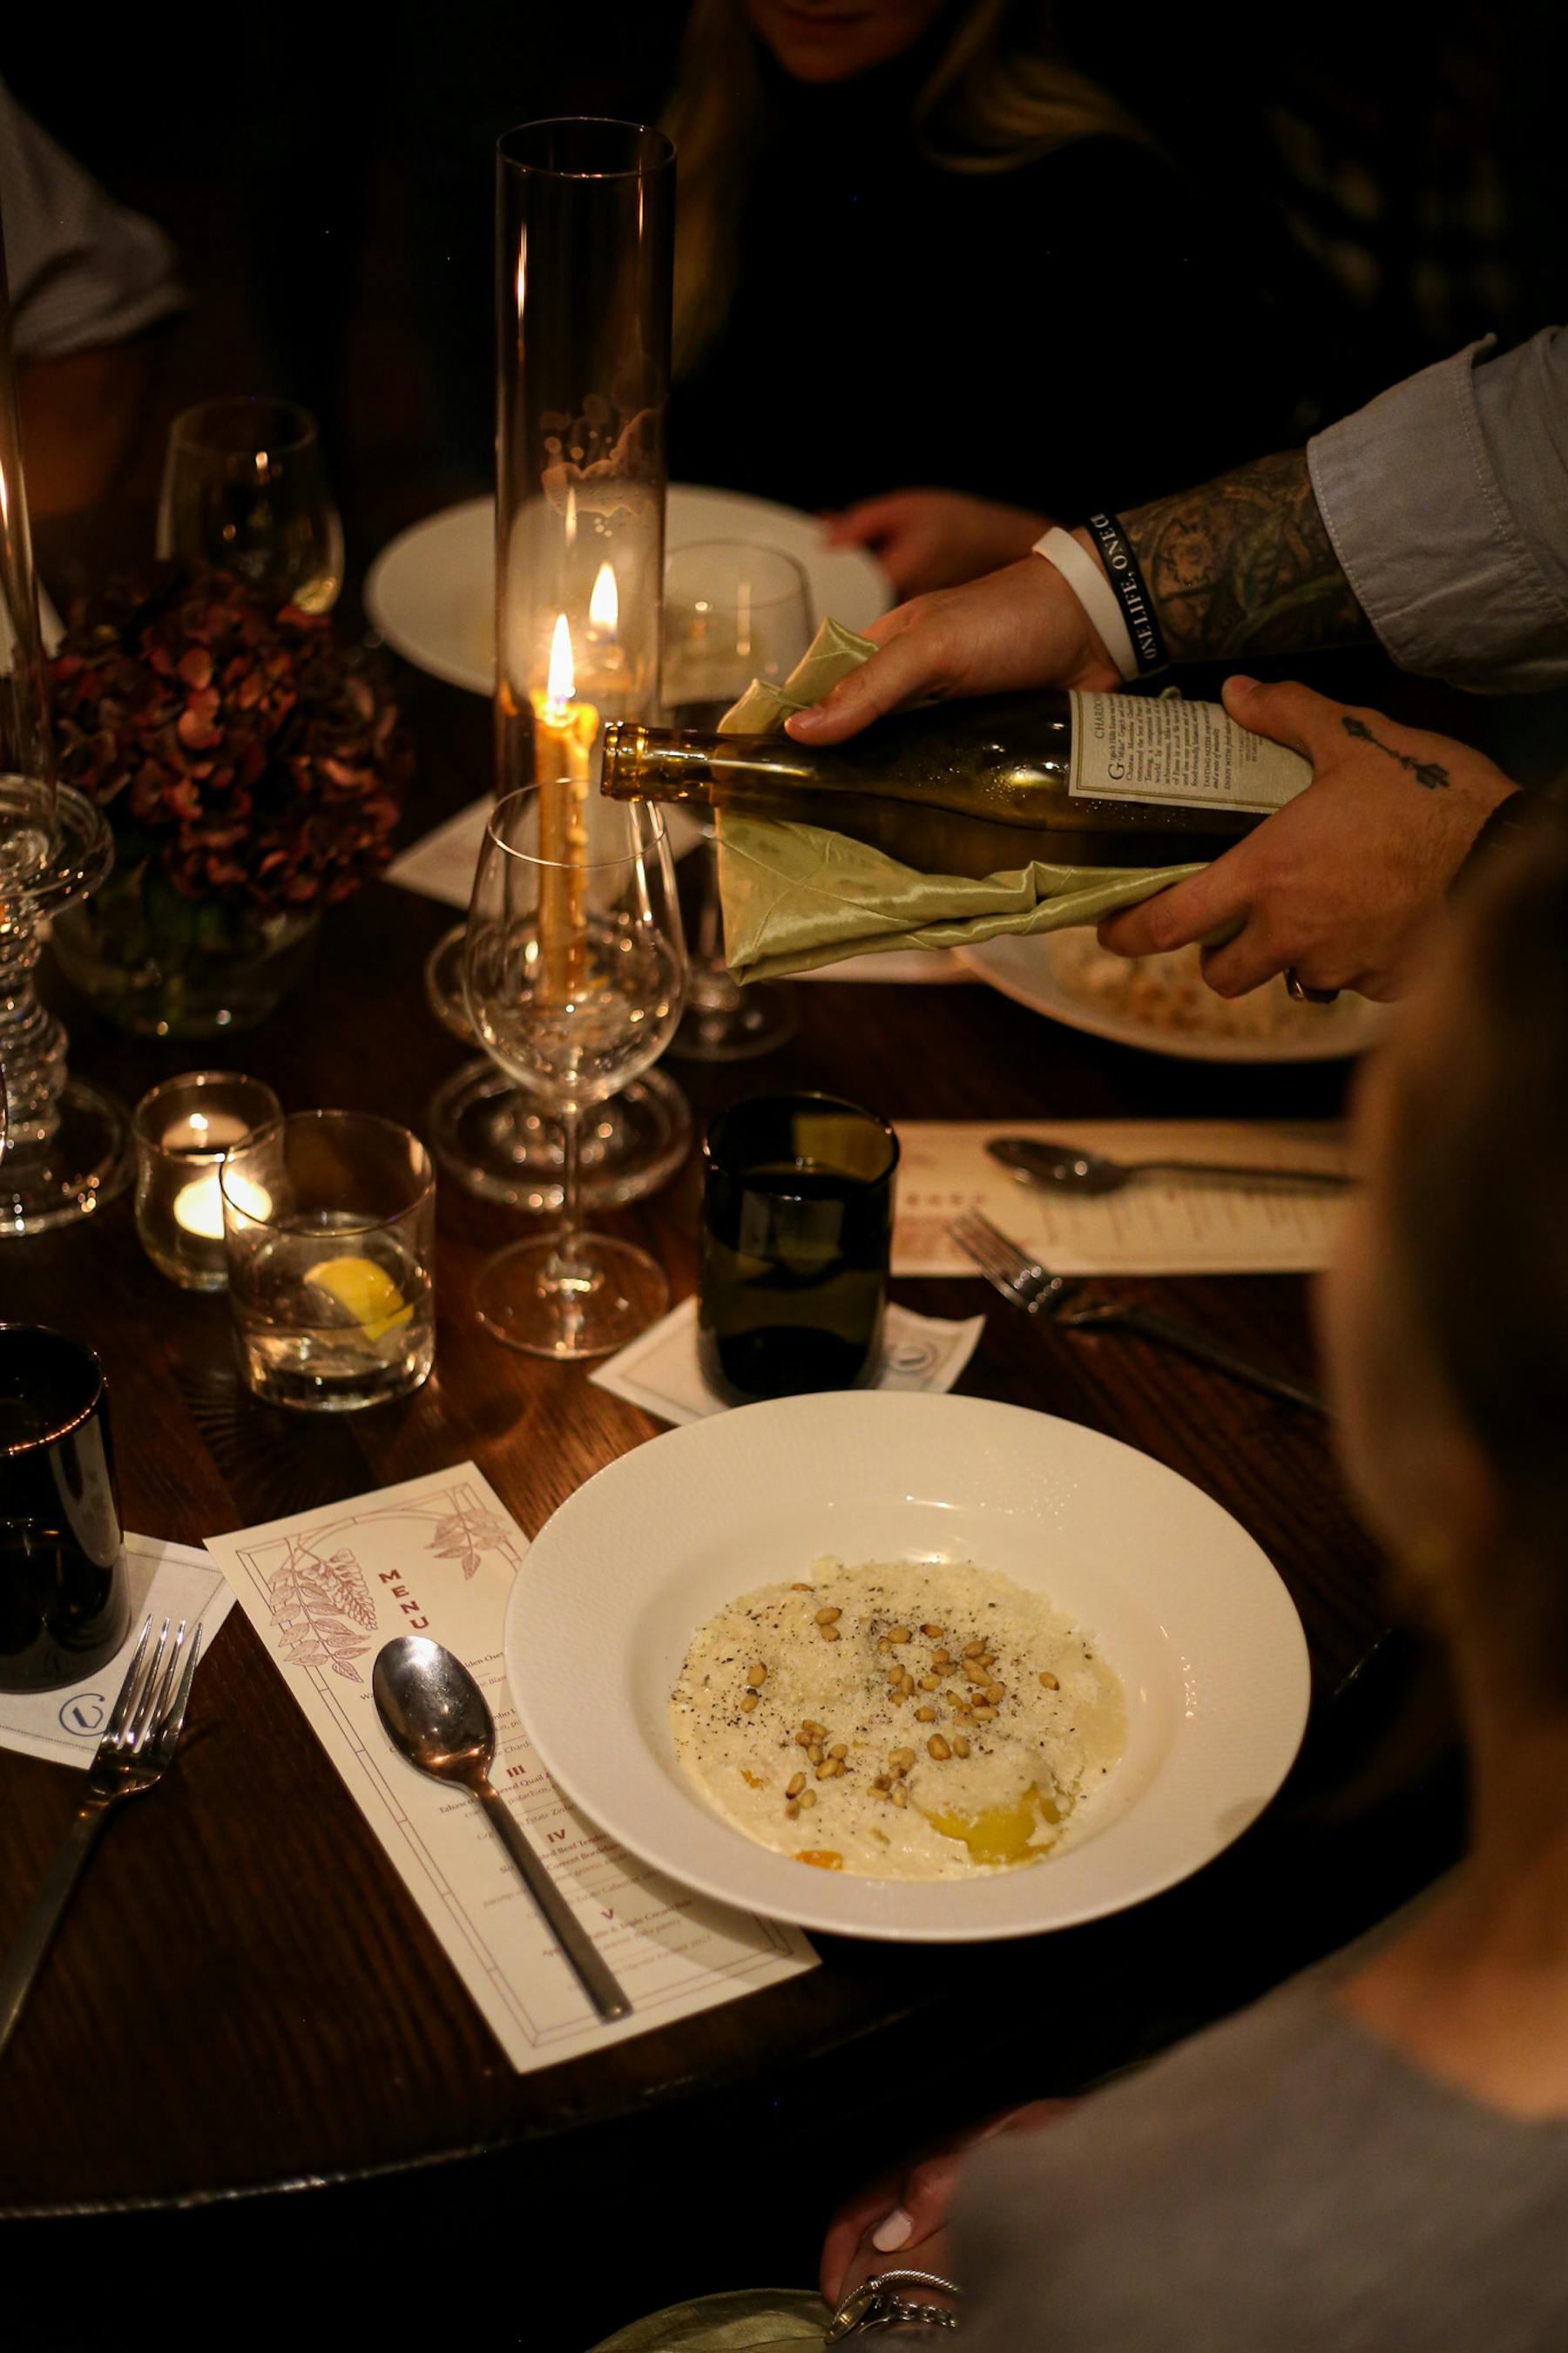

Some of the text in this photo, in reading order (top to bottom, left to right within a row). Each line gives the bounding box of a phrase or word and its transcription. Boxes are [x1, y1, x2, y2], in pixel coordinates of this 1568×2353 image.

[1098, 527, 1128, 571] ONE
[1120, 571, 1149, 625] LIFE,
[1136, 625, 1158, 660] ONE
[378, 1569, 429, 1629] MENU
[506, 1763, 526, 1777] III
[520, 1774, 544, 1788] Quail
[547, 1829, 565, 1843] IV
[600, 1908, 613, 1920] V
